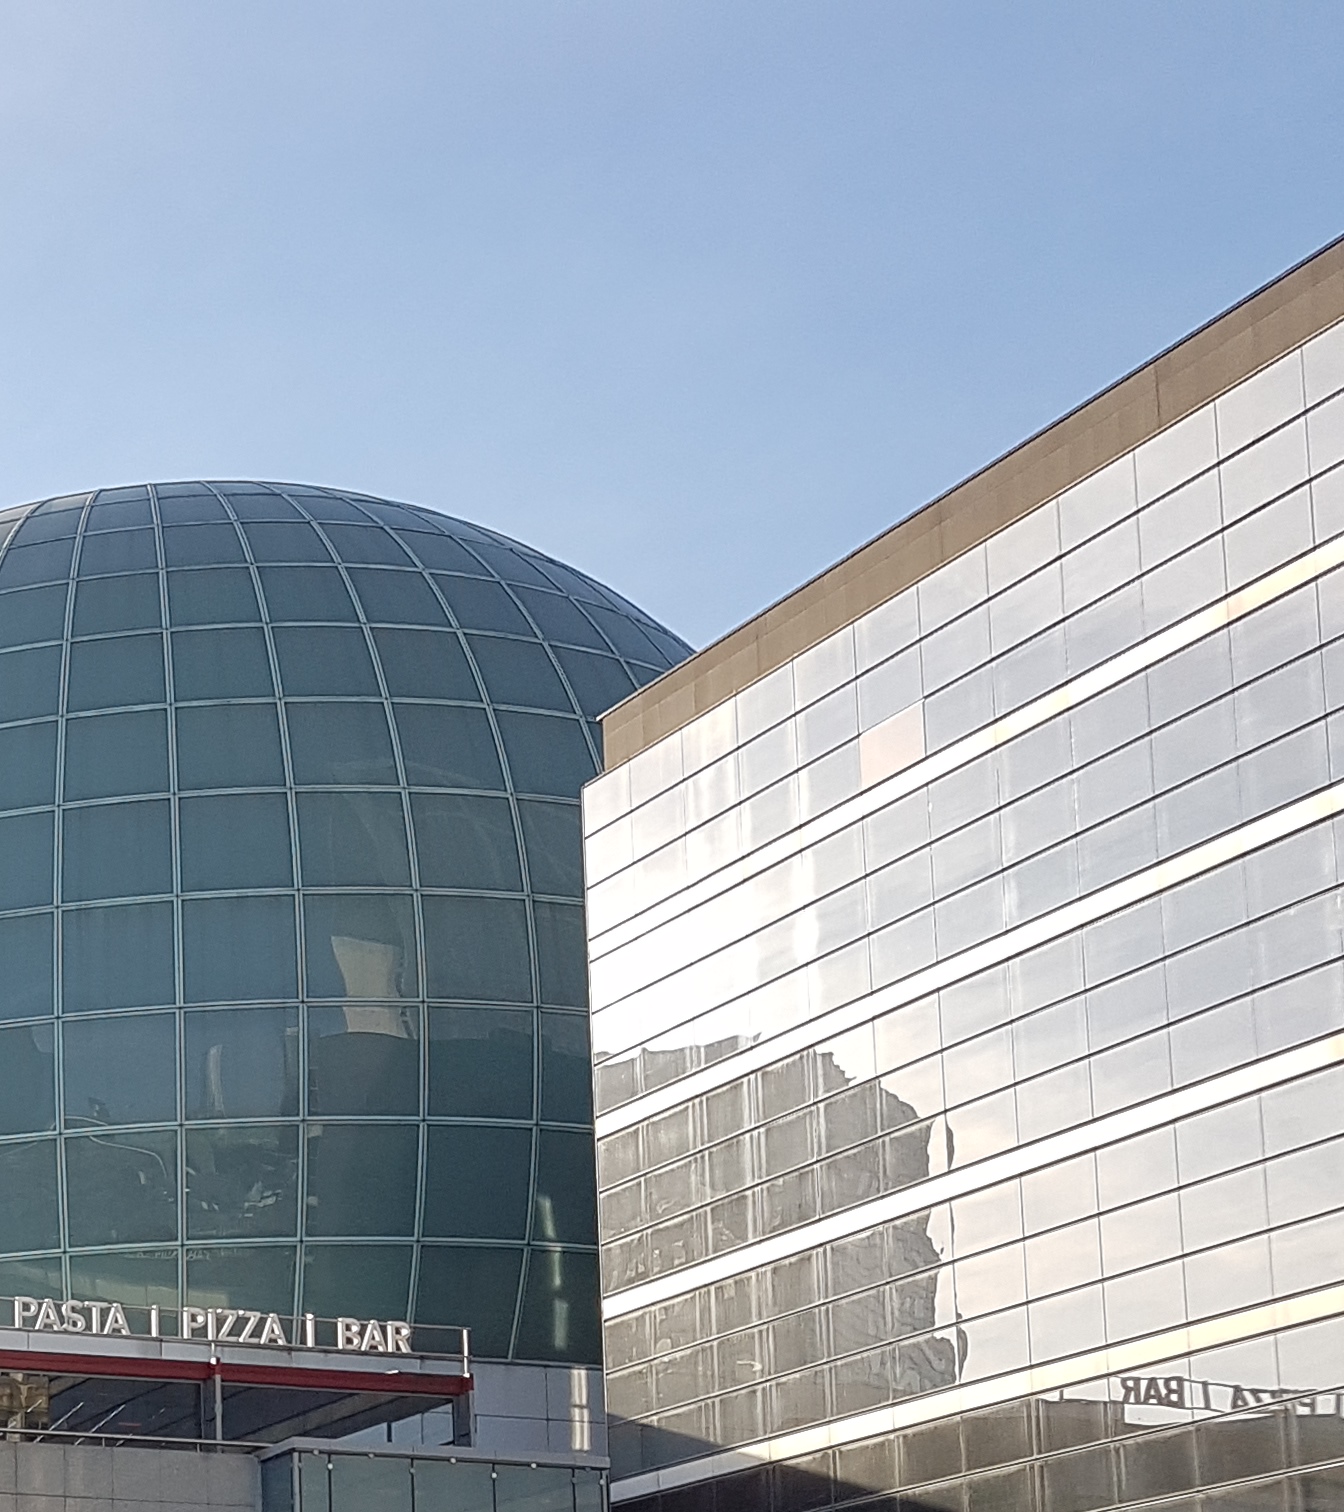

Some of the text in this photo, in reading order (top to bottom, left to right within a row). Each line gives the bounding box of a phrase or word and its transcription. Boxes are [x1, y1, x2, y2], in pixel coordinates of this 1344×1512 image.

[14, 1296, 413, 1354] PASTA PIZZA BAR
